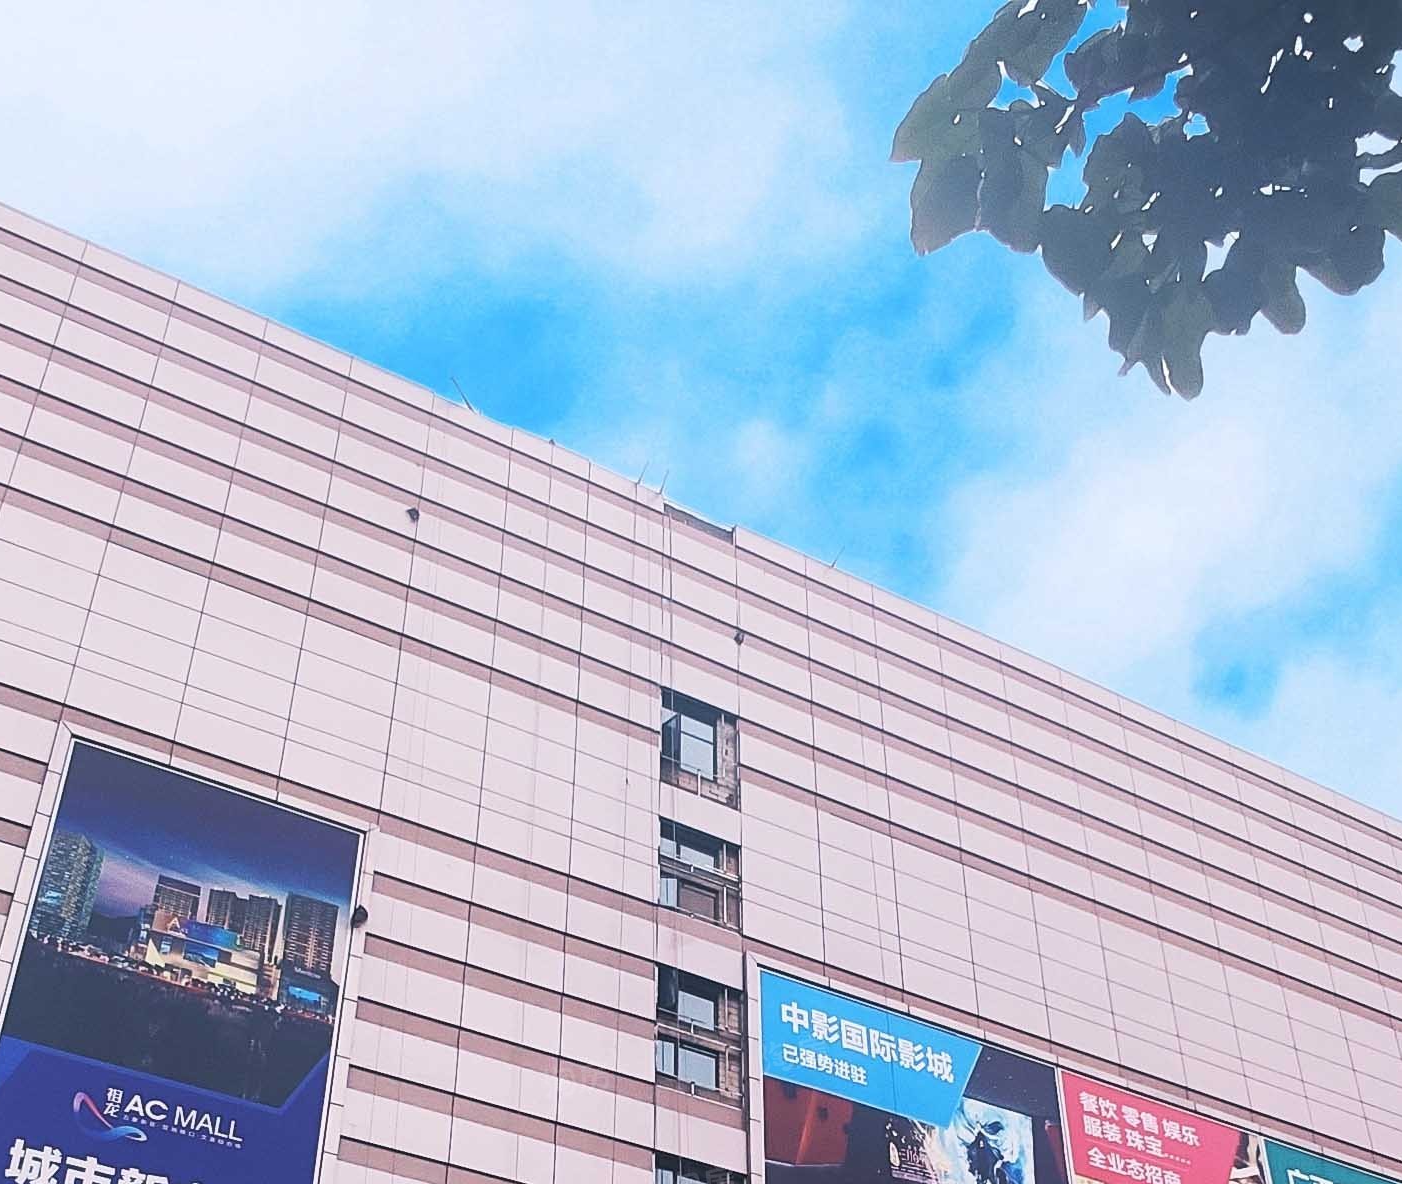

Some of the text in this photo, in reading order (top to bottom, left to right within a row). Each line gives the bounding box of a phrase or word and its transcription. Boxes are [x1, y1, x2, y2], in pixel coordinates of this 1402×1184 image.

[781, 1001, 955, 1083] 中影国际影城
[782, 1043, 868, 1085] 已强势进驻
[124, 1094, 168, 1120] AC
[174, 1106, 243, 1142] MALL
[1079, 1091, 1200, 1147] 餐饮 零售 娱乐
[1083, 1115, 1122, 1144] 服装
